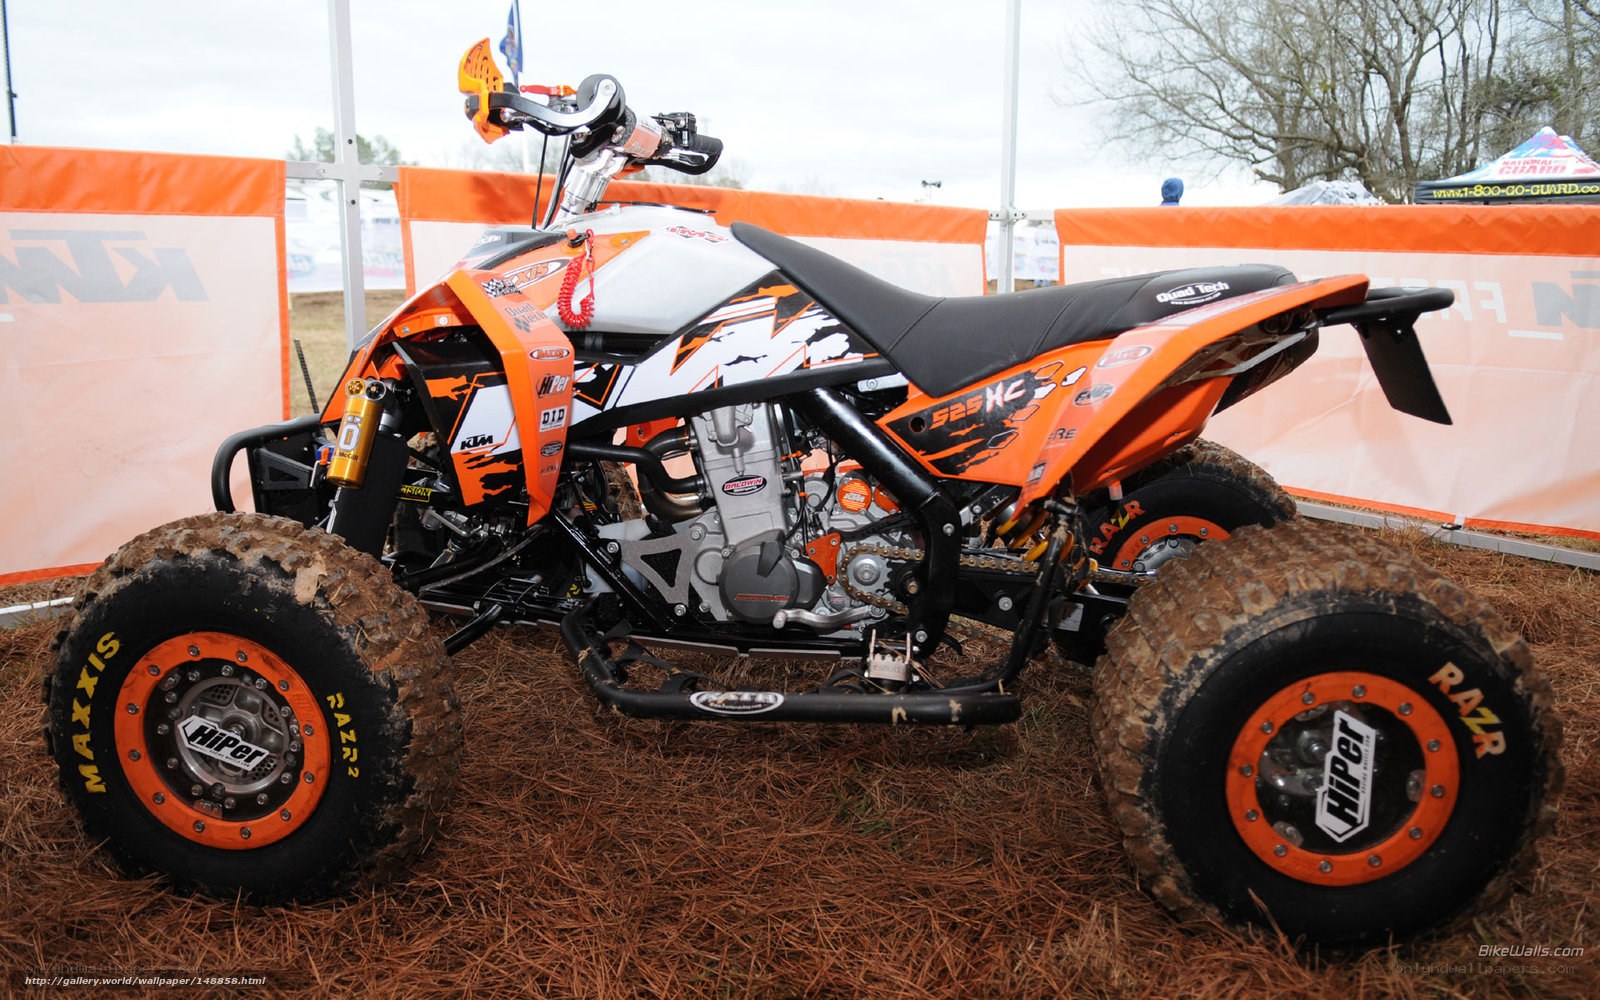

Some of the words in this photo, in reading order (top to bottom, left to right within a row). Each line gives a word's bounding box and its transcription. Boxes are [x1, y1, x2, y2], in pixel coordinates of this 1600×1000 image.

[1498, 165, 1567, 175] GUARD
[1433, 183, 1600, 198] www.1-800-GO-GUARD.co
[1156, 286, 1195, 303] Quad
[1195, 281, 1230, 294] Tech
[504, 303, 535, 317] Quad
[520, 311, 548, 323] Tech
[540, 374, 571, 396] HiPer
[929, 394, 983, 430] 525
[460, 434, 493, 450] KTM
[725, 478, 763, 489] BALDWIN
[1089, 500, 1146, 555] RAZR
[71, 631, 120, 794] MAXXIS
[1428, 661, 1506, 759] RAZR
[189, 724, 265, 763] HiPer
[1327, 718, 1364, 827] HiPer
